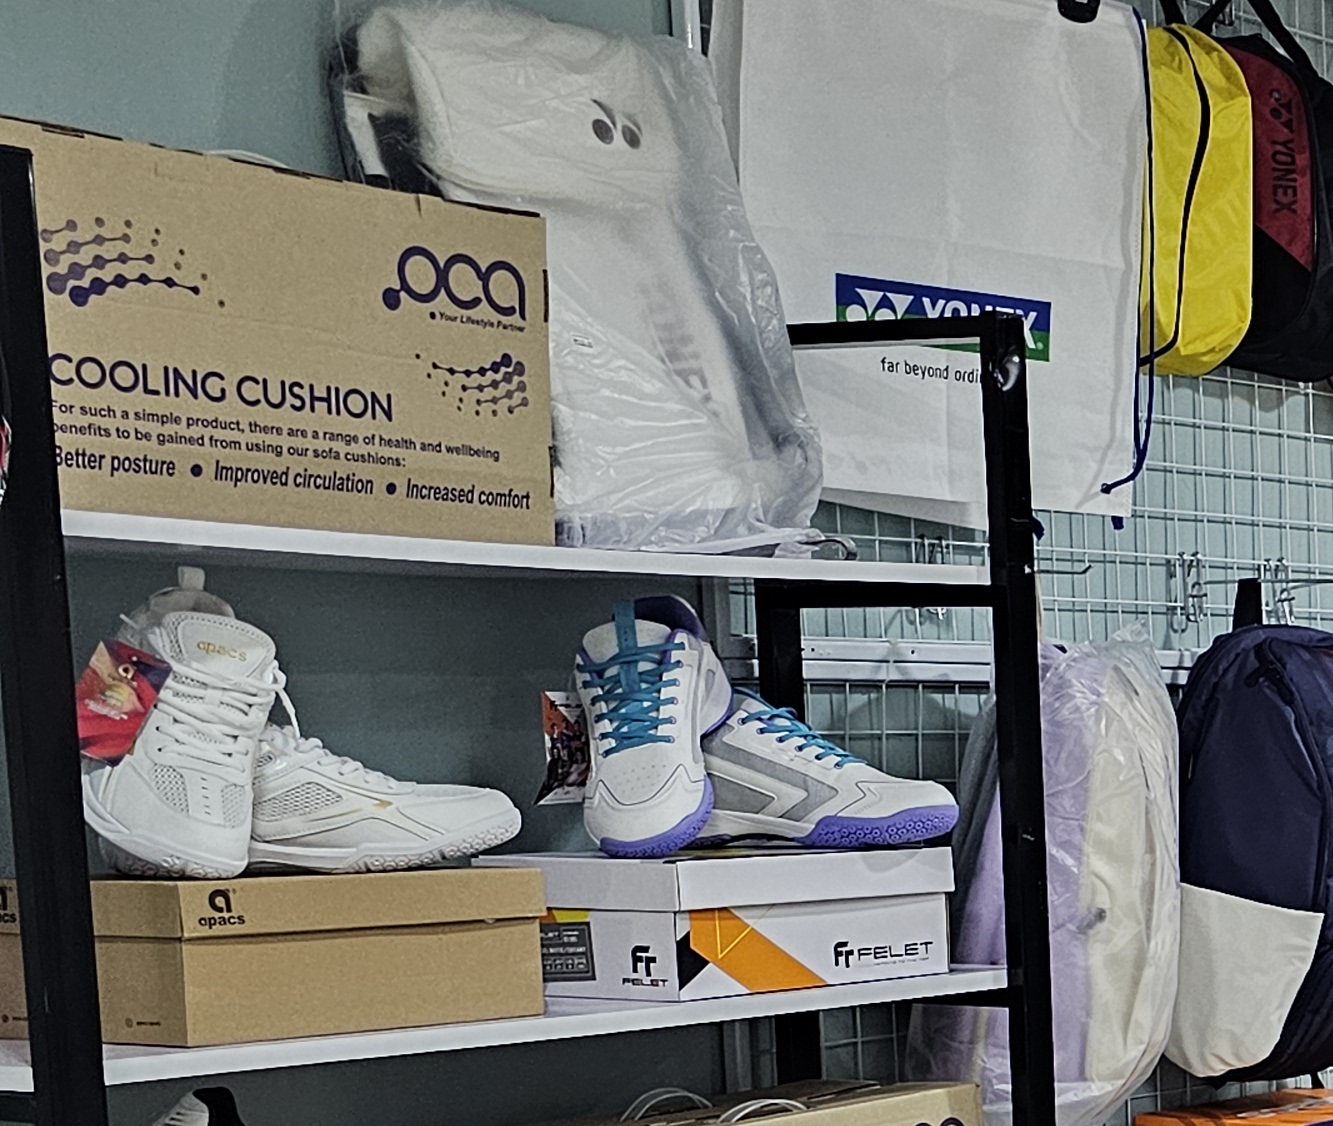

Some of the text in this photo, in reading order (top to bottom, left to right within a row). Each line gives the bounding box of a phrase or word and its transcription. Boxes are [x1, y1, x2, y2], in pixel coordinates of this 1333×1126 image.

[1272, 139, 1298, 215] YONEX
[49, 352, 393, 423] COOLING CUSHION
[881, 357, 981, 384] far beyond ordi
[79, 405, 117, 419] such
[133, 408, 182, 427] simple
[186, 416, 245, 434] product,
[248, 420, 283, 436] there
[286, 427, 308, 439] are
[322, 431, 359, 447] range
[362, 433, 376, 447] of
[378, 434, 417, 451] health
[419, 440, 443, 454] and
[444, 443, 500, 463] wellbeing
[115, 426, 131, 440] to
[134, 427, 153, 442] be
[156, 431, 206, 447] gained
[208, 435, 242, 451] from
[245, 440, 284, 458] using
[286, 445, 310, 458] our
[312, 447, 341, 461] sofa
[343, 451, 406, 468] cushions:
[110, 454, 176, 478] posture
[214, 459, 290, 489] Improved
[293, 467, 374, 495] circulation
[406, 477, 476, 505] Increased
[477, 487, 531, 510] comfort
[197, 640, 248, 663] apacs
[199, 911, 246, 928] apacs
[857, 940, 933, 962] FELET
[622, 977, 668, 987] FELET
